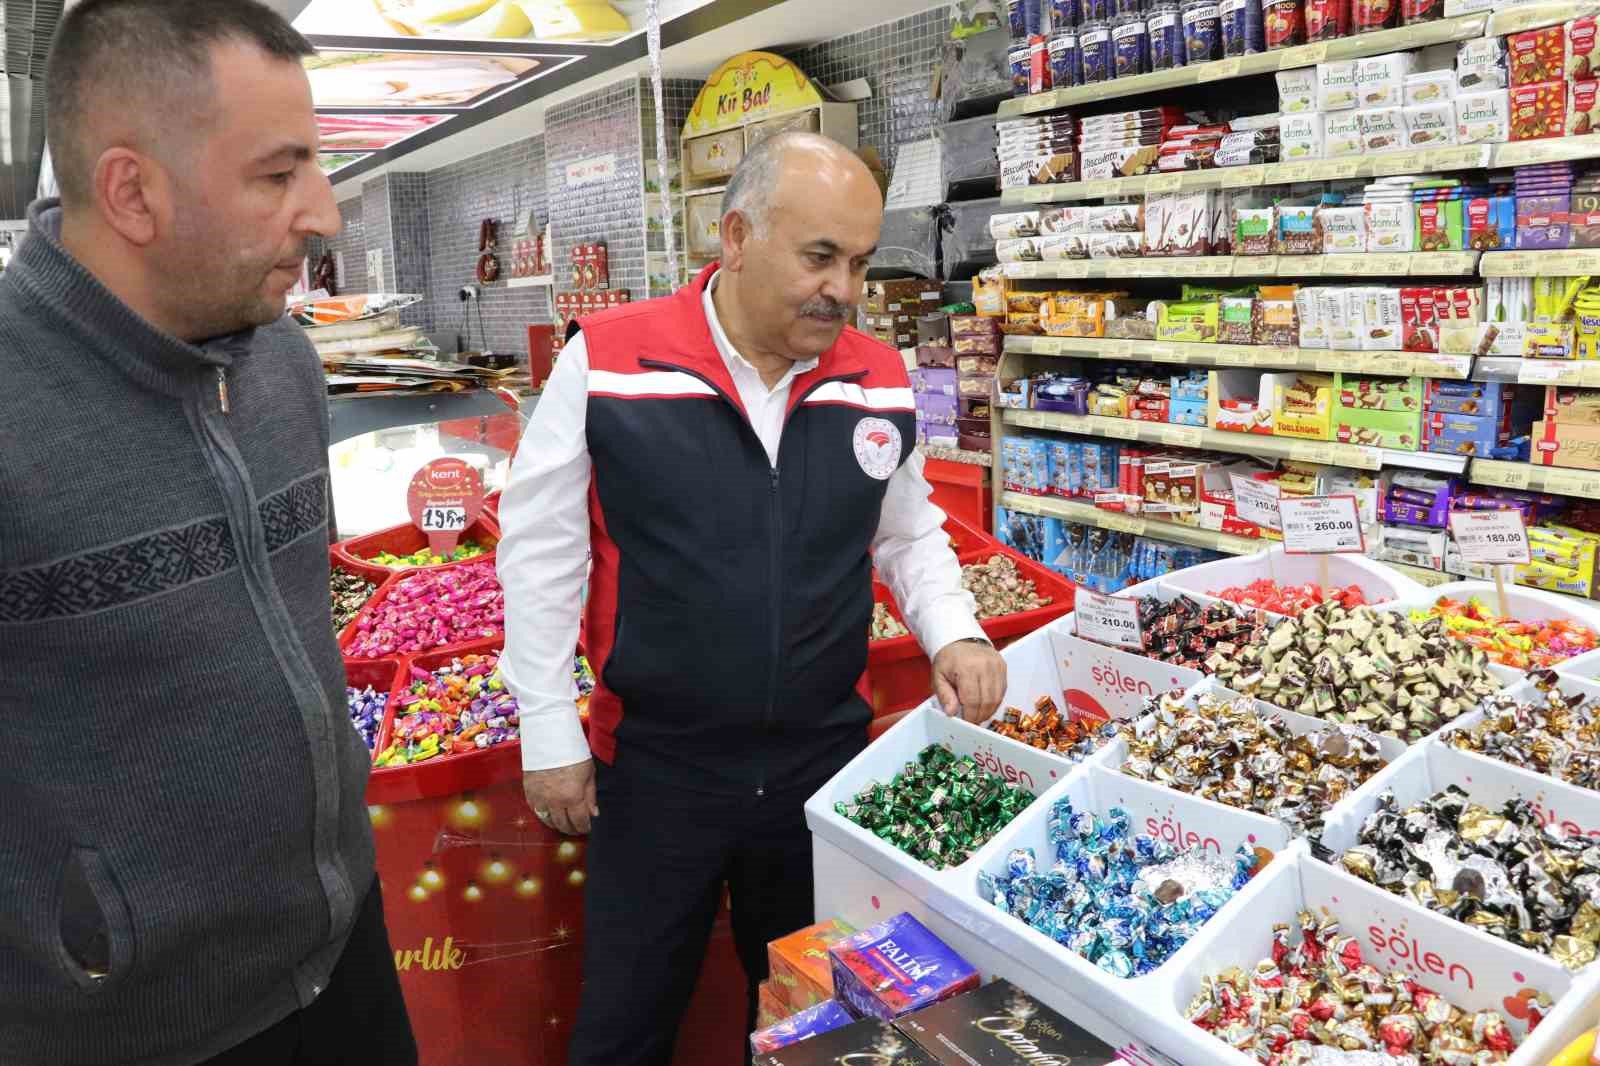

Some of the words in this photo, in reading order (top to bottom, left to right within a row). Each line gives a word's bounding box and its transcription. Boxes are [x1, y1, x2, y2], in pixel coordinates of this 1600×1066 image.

[743, 82, 770, 113] Bal
[1462, 102, 1498, 121] damak
[1277, 422, 1321, 435] TOBLERONE
[431, 469, 461, 479] kent
[1314, 520, 1353, 531] 260.00
[1486, 533, 1521, 543] 189.00
[1102, 617, 1136, 630] 210.00
[1091, 664, 1153, 696] şölen
[973, 749, 1034, 788] şölen
[1146, 815, 1222, 854] şölen
[877, 938, 931, 981] FALIM
[1368, 924, 1475, 991] şölen
